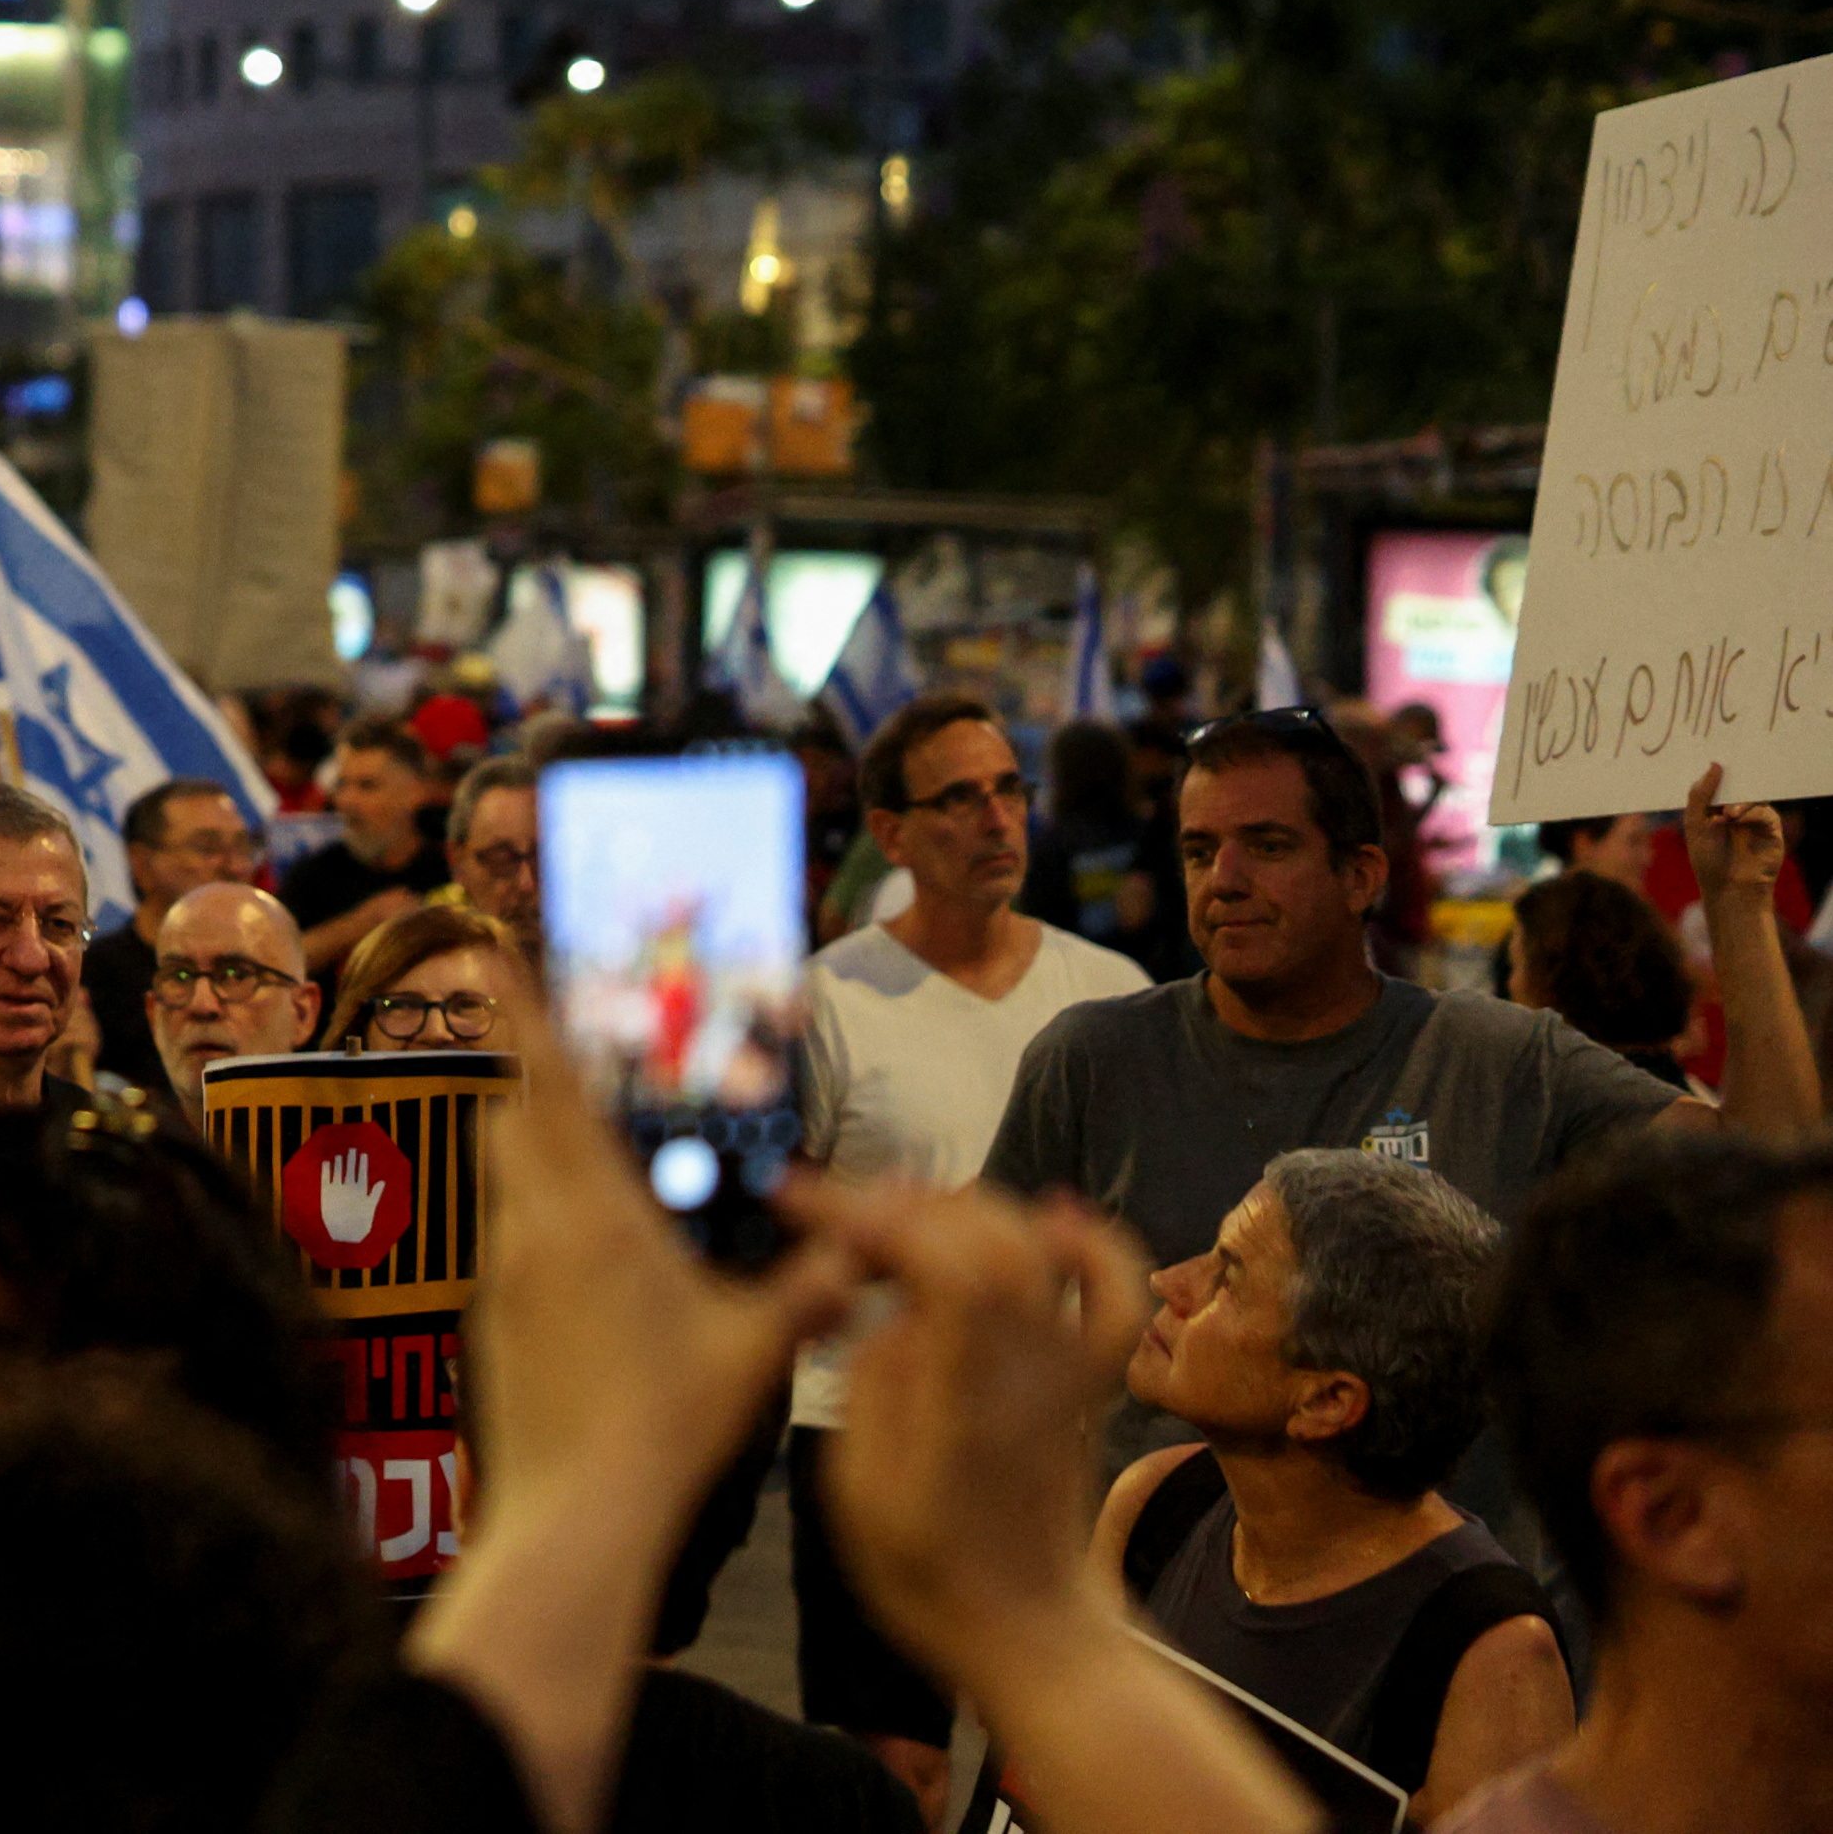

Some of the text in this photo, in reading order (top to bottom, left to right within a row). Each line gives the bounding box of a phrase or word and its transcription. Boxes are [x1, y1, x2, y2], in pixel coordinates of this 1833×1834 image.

[1583, 83, 1797, 353] זה ניצחון
[1574, 455, 1728, 557] תבוסה
[1748, 447, 1790, 537] זו
[1512, 657, 1606, 803] עכשיו
[1614, 636, 1745, 758] אותם
[1768, 626, 1833, 734] יא
